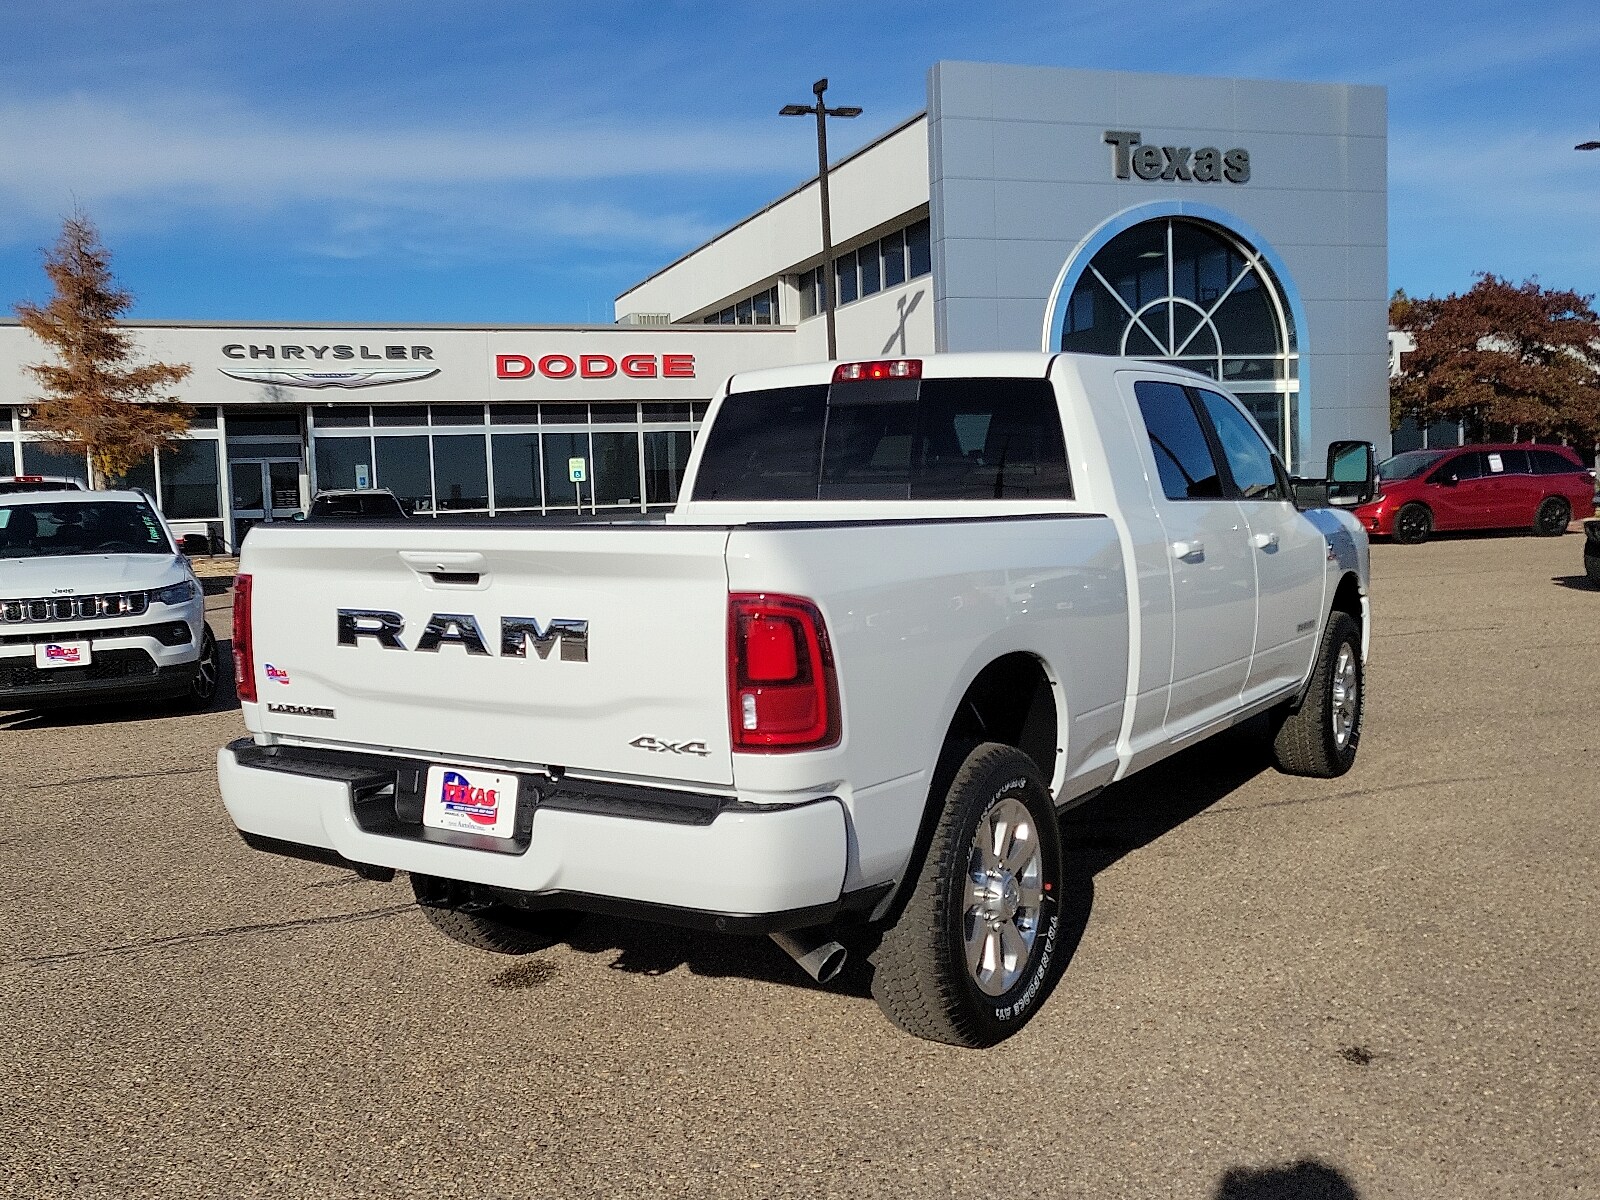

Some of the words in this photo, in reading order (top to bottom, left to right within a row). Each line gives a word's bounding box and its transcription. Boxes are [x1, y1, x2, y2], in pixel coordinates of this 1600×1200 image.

[1103, 130, 1250, 184] Texas
[221, 344, 436, 360] CHRYSLER
[496, 354, 695, 379] DODGE
[337, 607, 589, 663] RAM
[444, 783, 496, 807] TEXAS
